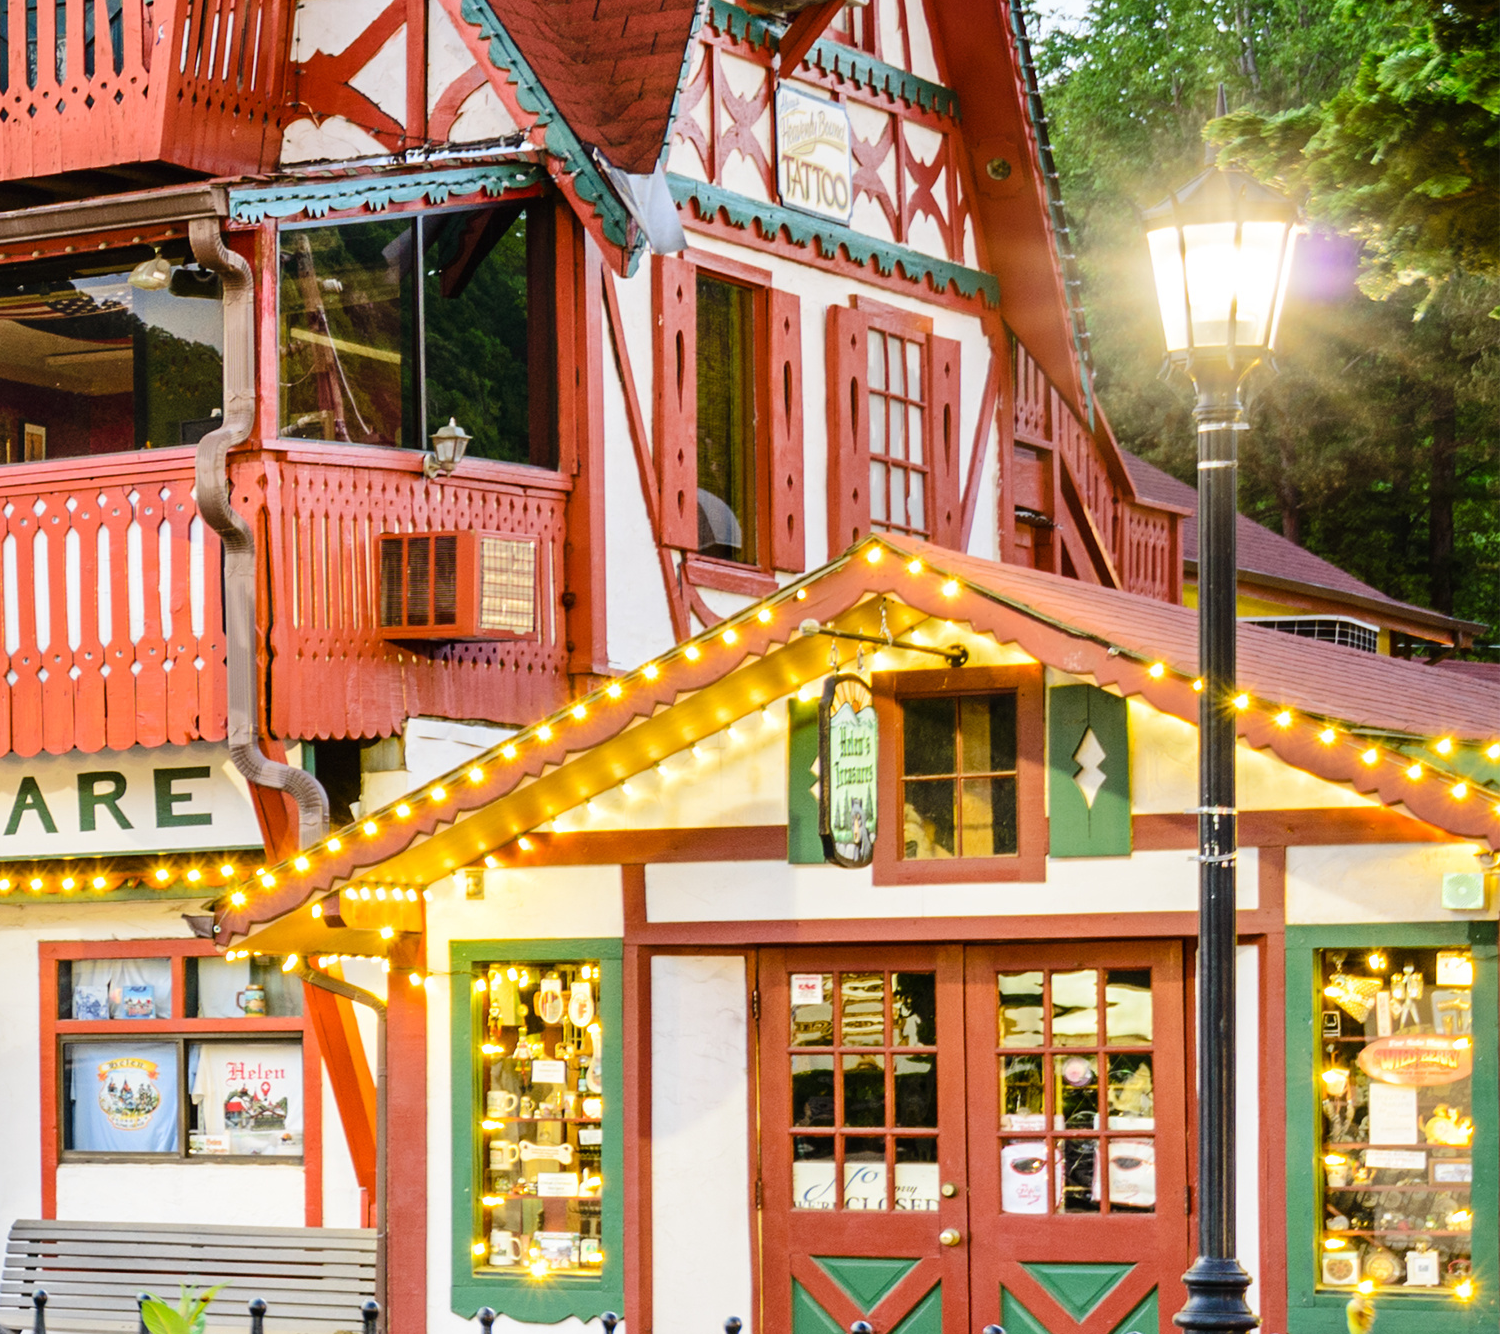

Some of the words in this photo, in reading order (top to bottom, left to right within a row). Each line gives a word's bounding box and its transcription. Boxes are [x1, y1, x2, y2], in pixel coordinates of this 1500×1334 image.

[781, 112, 818, 150] Heavenly
[819, 111, 846, 142] Bound
[781, 154, 848, 210] TATTOO
[839, 726, 870, 757] Helen's
[835, 762, 873, 789] Treasures
[225, 1062, 286, 1086] Helen
